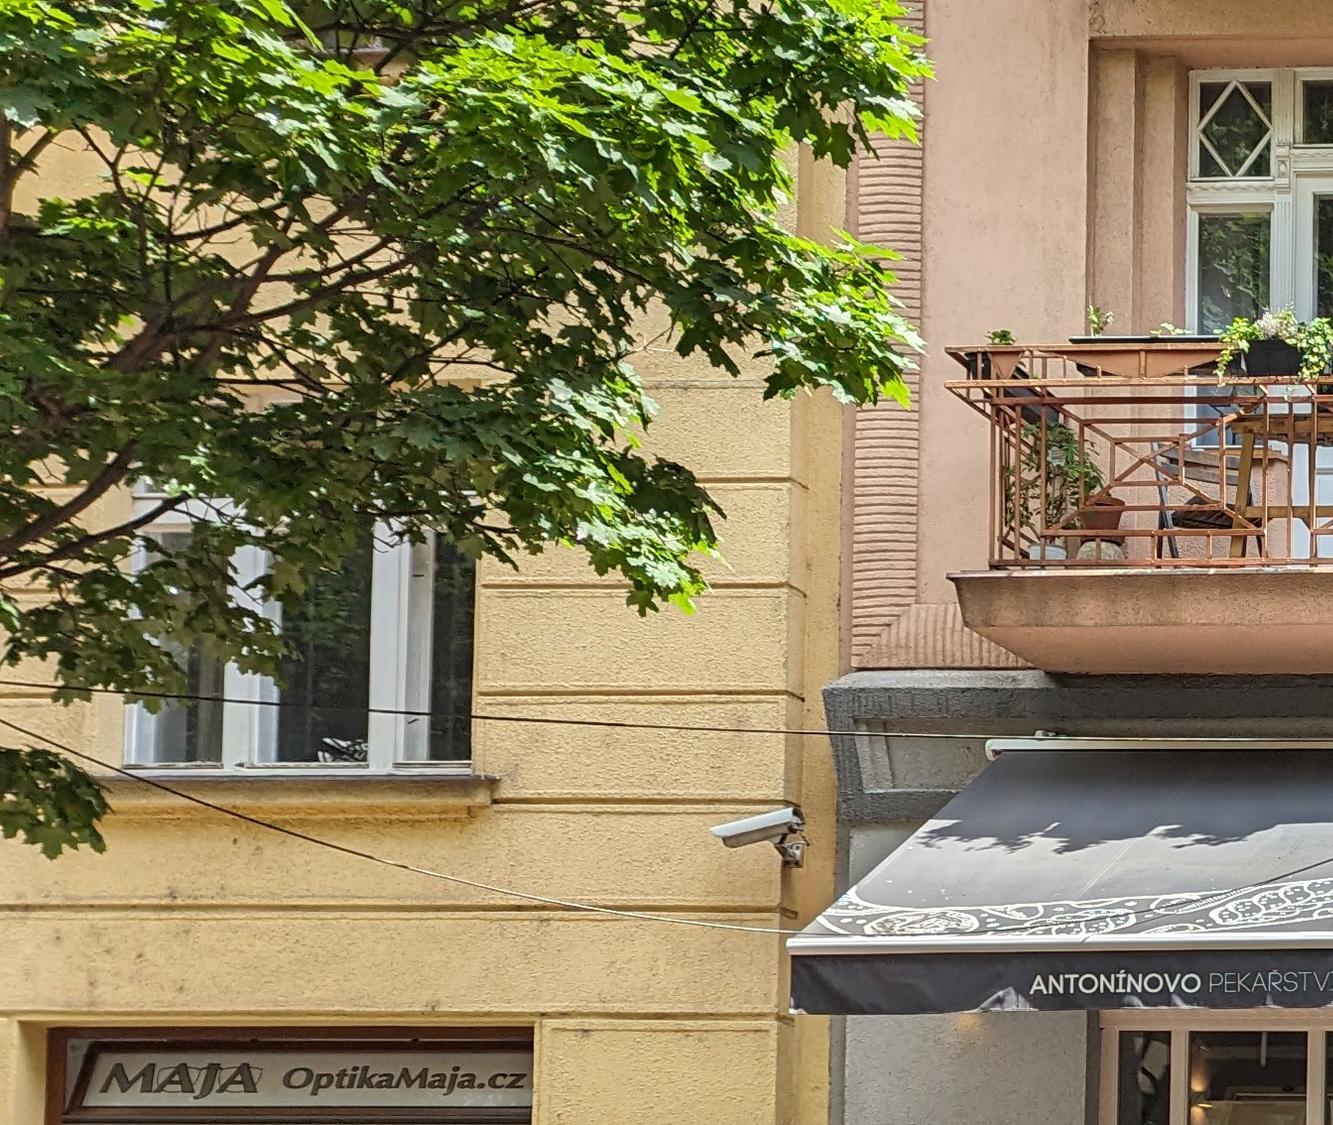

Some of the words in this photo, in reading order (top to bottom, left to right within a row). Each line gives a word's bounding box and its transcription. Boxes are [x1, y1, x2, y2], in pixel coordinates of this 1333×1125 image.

[1029, 969, 1201, 995] ANTONÍNOVO
[100, 1062, 261, 1099] MAJA
[282, 1065, 528, 1096] OptikaMaja.cz
